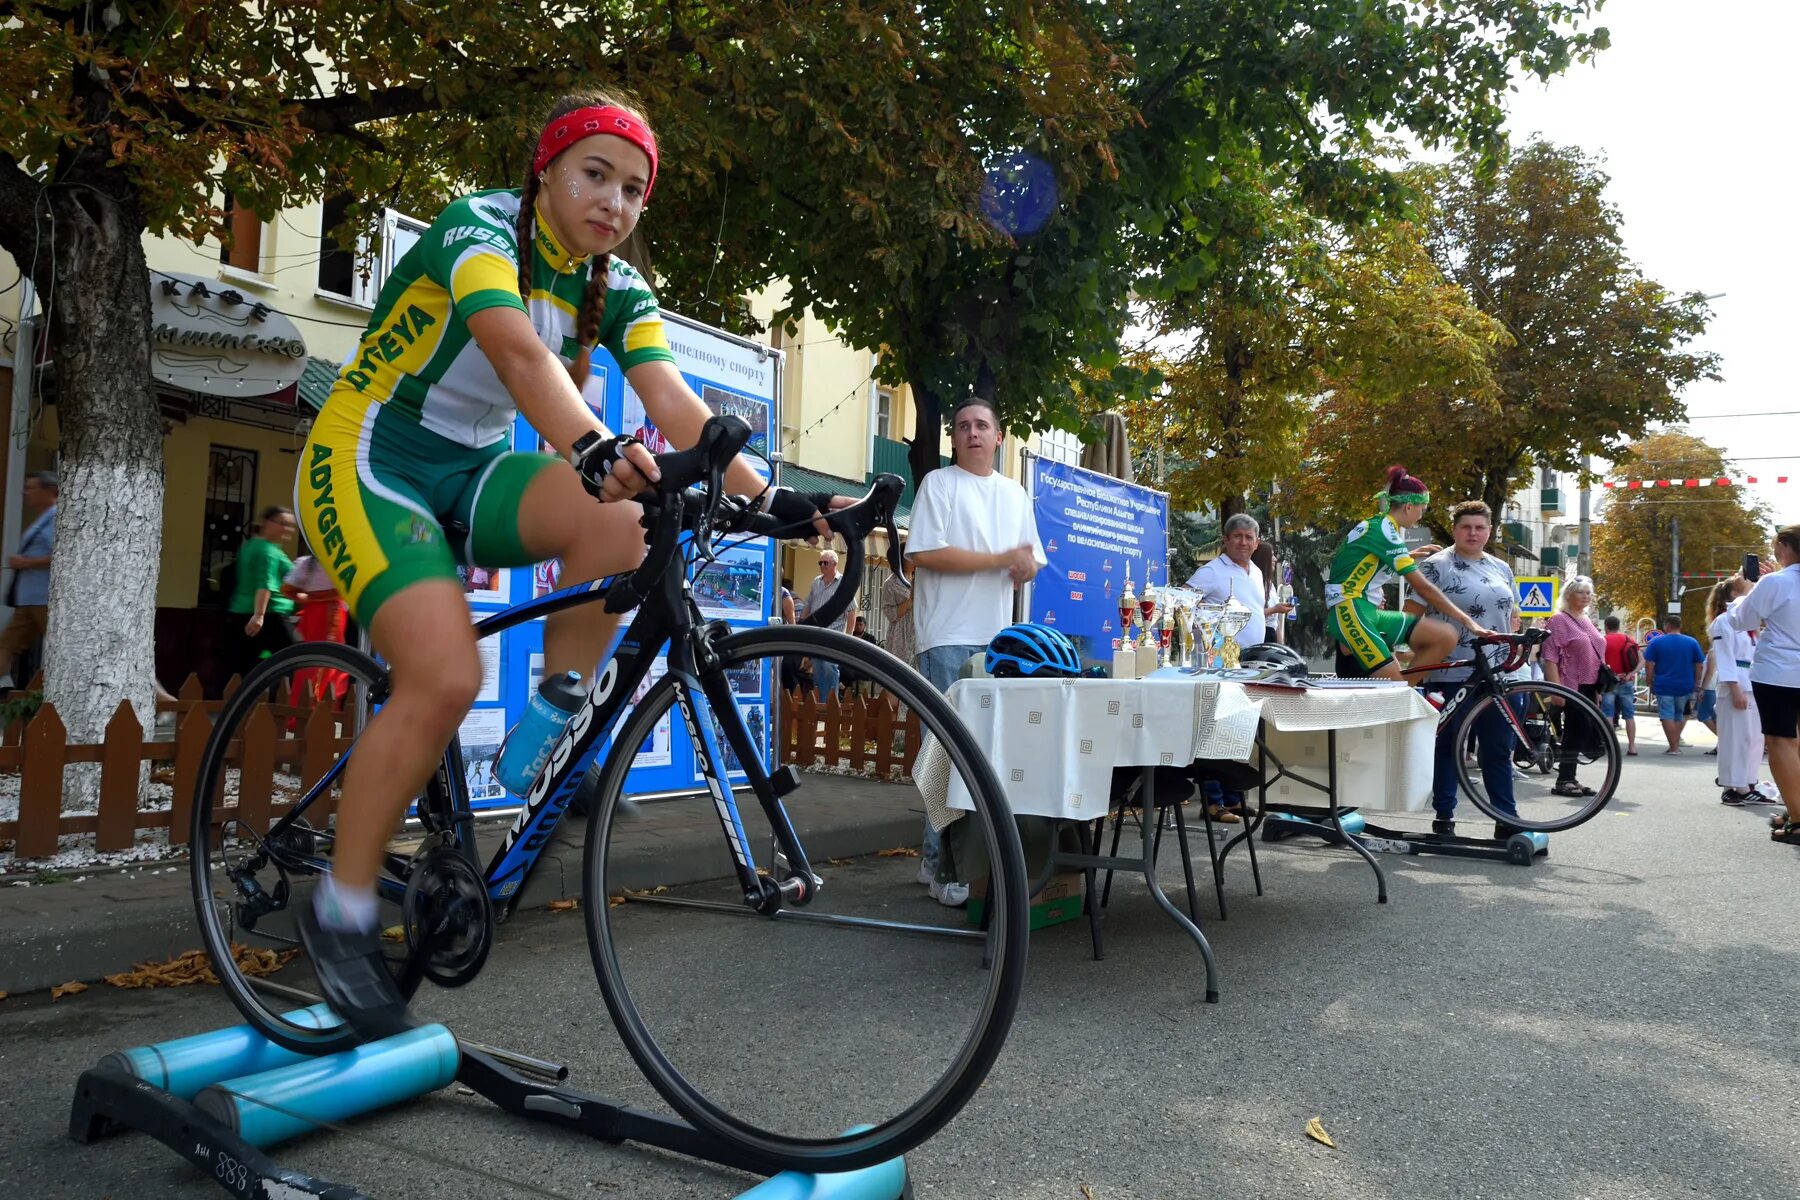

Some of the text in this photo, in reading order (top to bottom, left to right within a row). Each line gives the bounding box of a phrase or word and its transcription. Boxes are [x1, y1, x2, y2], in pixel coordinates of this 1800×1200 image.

[443, 226, 517, 266] RUSSI
[160, 280, 272, 322] КАФЕ
[667, 340, 765, 386] ипедному спорту
[310, 443, 357, 593] ADYGEYA
[1338, 605, 1376, 663] ADYGEYA
[672, 681, 709, 772] MOSSO
[505, 657, 618, 852] MOSSO
[215, 1151, 248, 1191] 888
